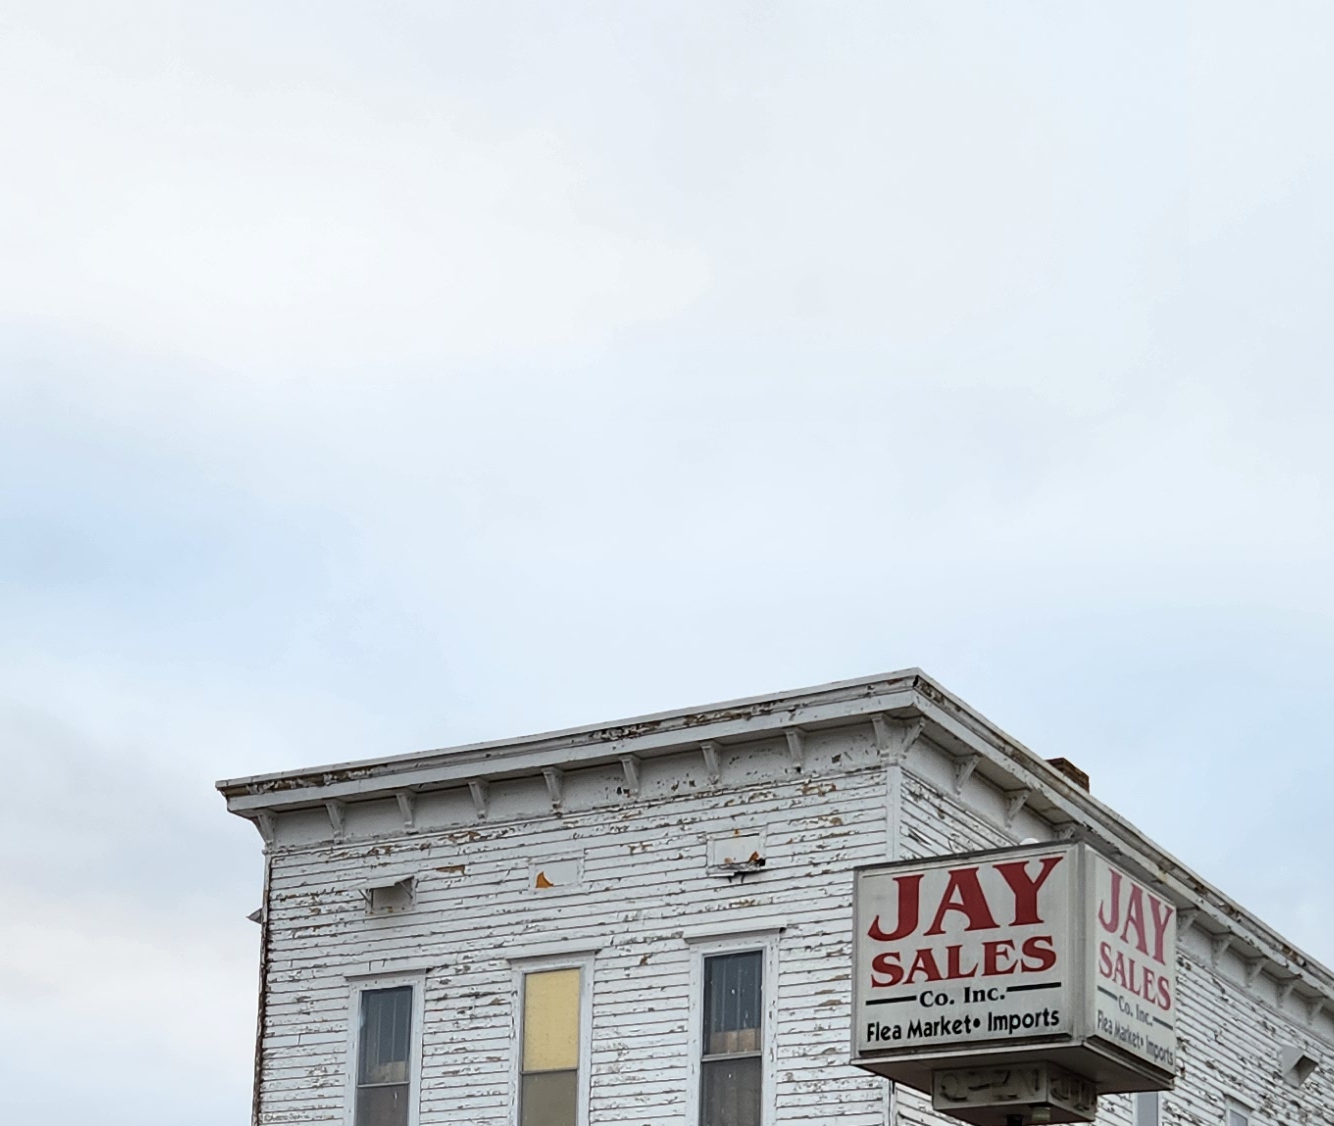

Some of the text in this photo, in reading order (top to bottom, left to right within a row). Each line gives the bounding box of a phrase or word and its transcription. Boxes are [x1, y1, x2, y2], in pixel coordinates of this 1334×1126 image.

[867, 856, 1064, 942] JAY
[1097, 867, 1174, 966] JAY
[870, 935, 1058, 989] SALES
[1098, 941, 1171, 1011] SALES
[867, 1021, 902, 1043] Flea
[987, 1007, 1060, 1035] Imports
[919, 986, 1006, 1008] Co. Inc.
[1118, 995, 1153, 1027] Co. Inc.
[1097, 1009, 1113, 1035] Flea
[1145, 1034, 1174, 1067] Imports
